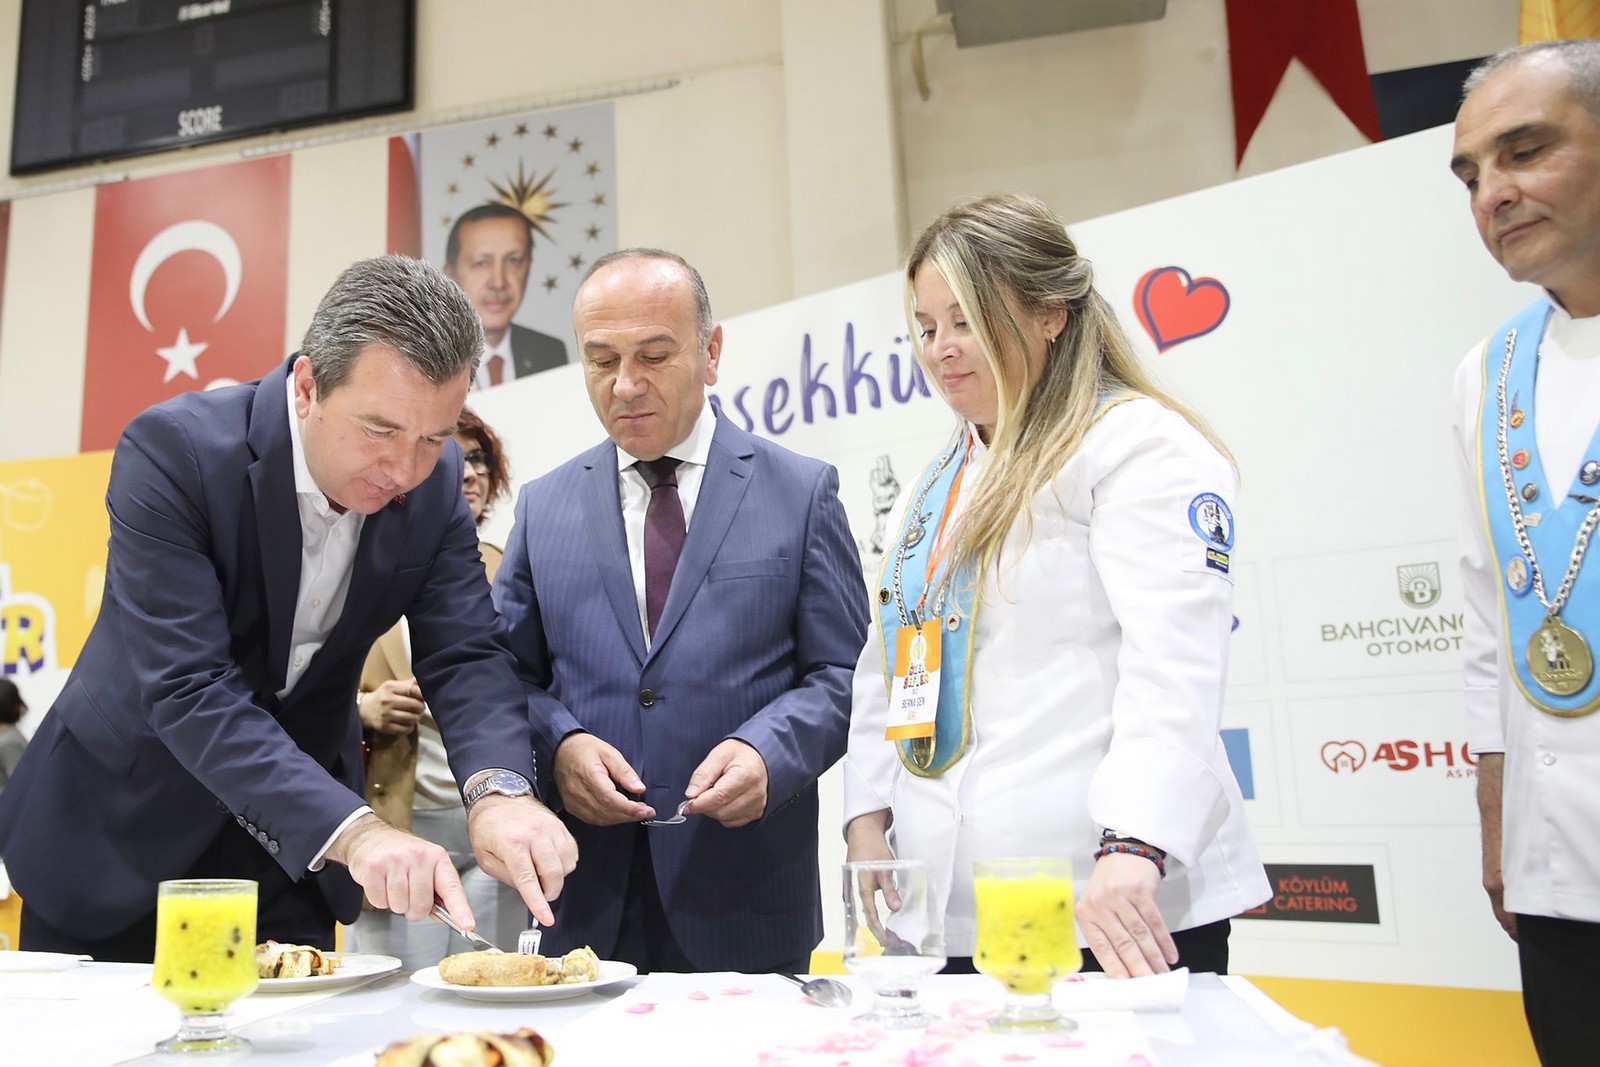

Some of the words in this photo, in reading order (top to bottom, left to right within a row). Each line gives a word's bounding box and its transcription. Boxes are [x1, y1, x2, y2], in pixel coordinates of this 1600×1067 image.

[178, 105, 222, 136] SCORE
[0, 603, 45, 674] R
[1367, 636, 1463, 656] OTOMOT
[1278, 875, 1349, 895] KÖYLÜM
[1272, 894, 1358, 913] CATERING
